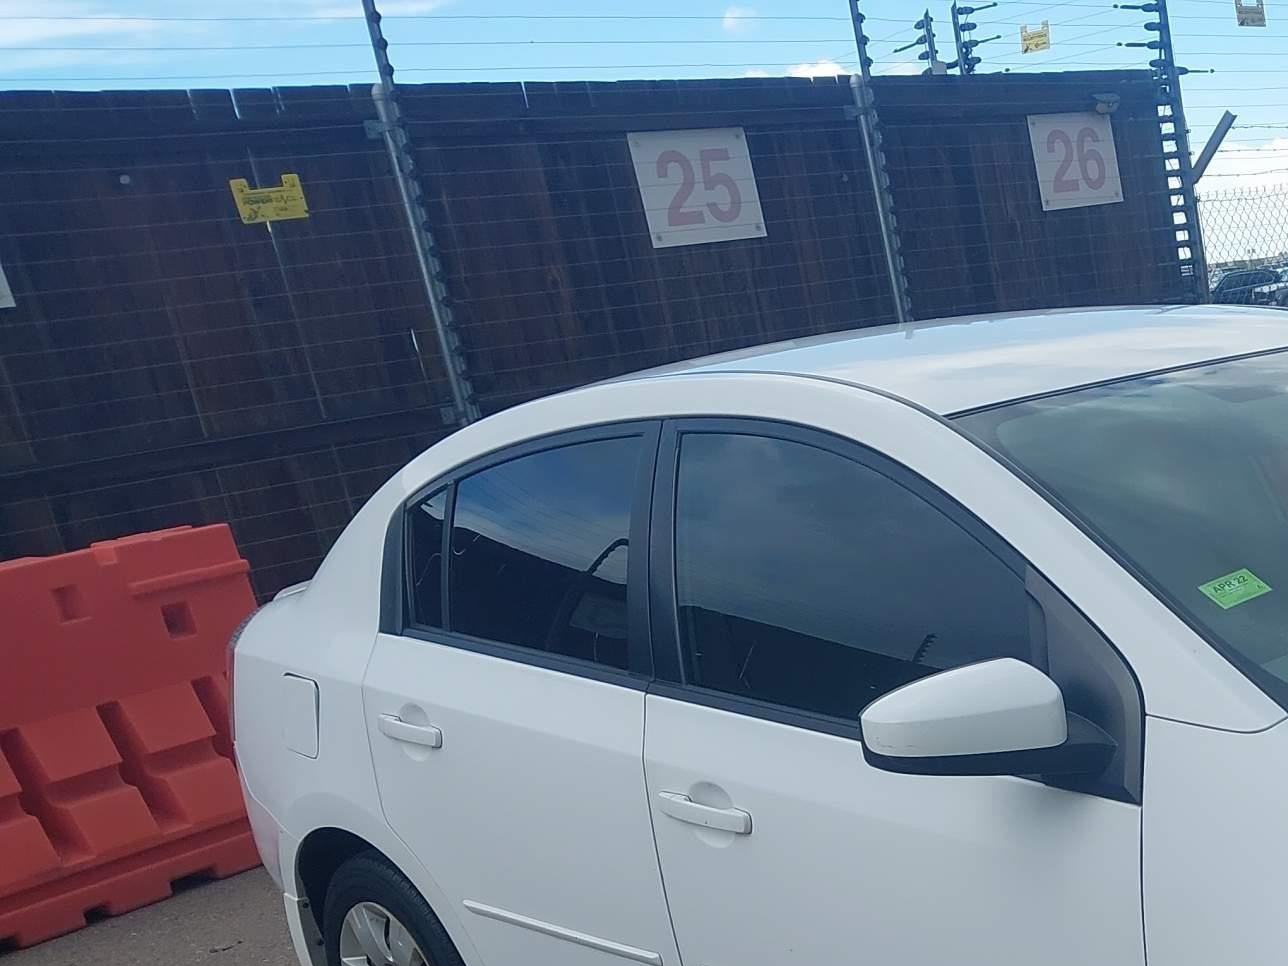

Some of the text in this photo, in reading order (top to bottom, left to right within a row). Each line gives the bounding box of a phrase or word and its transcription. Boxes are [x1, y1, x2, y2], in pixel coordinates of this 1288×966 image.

[656, 147, 742, 227] 25
[1046, 126, 1106, 193] 26
[1212, 580, 1235, 594] APR
